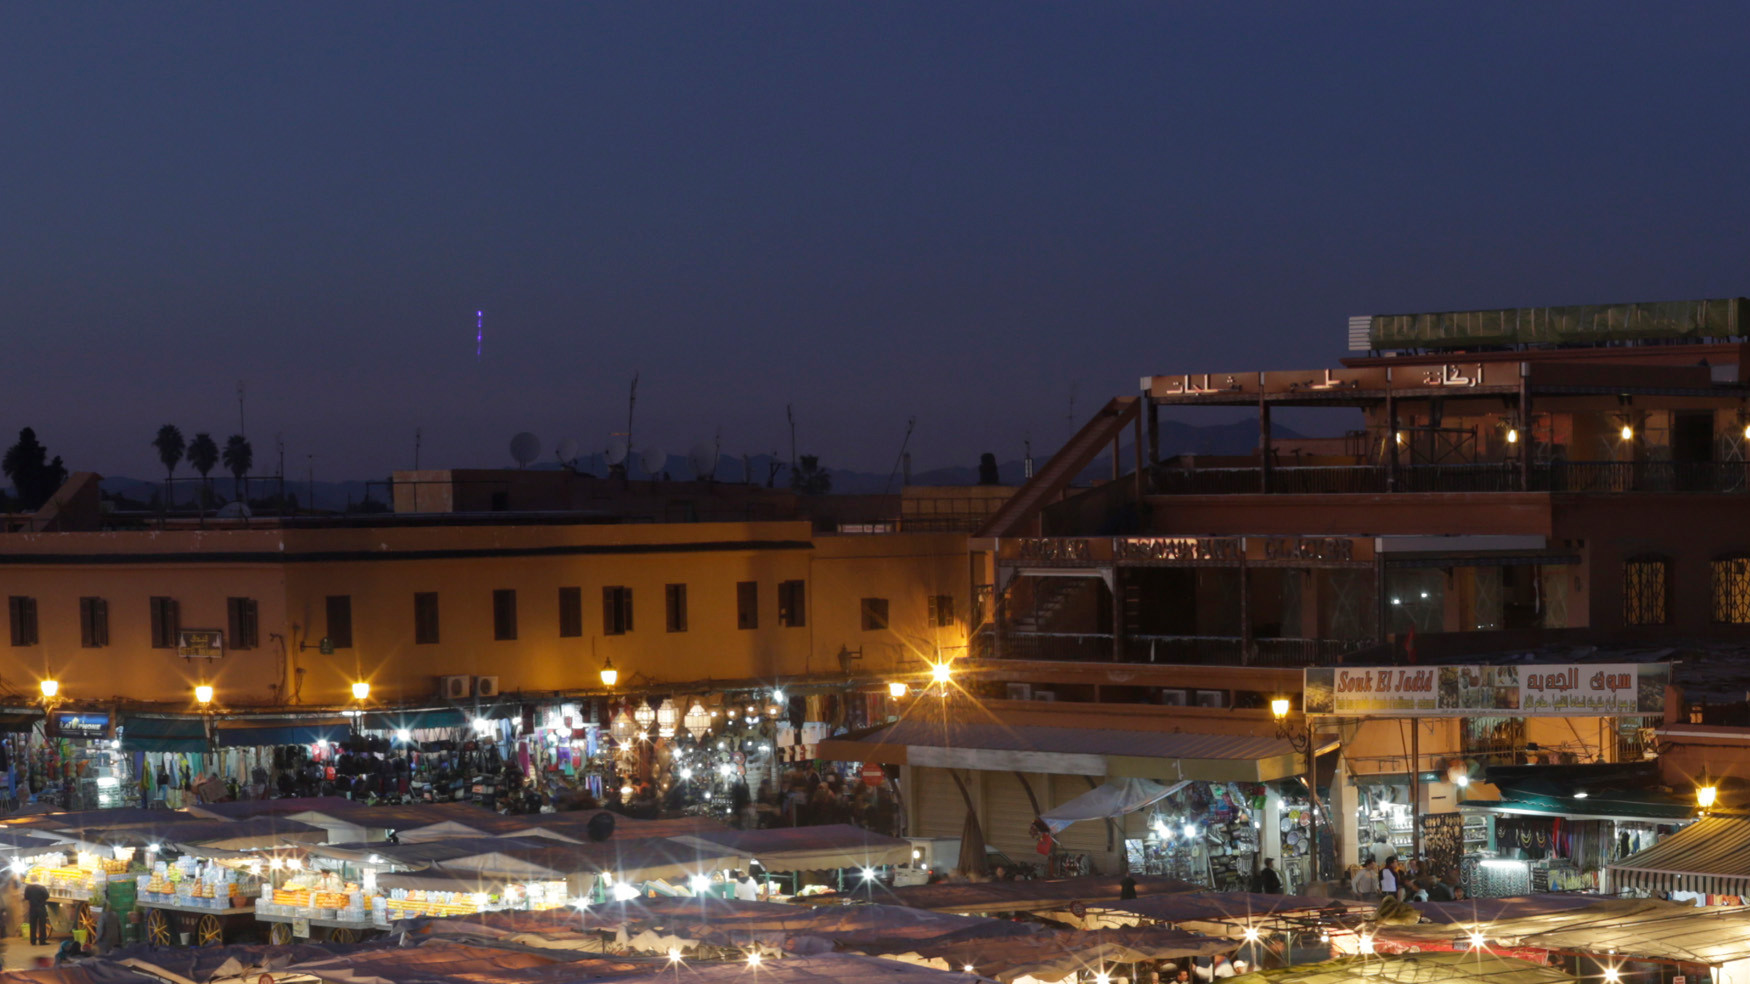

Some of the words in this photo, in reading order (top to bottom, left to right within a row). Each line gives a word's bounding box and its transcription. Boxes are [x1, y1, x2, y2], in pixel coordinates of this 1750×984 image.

[1338, 671, 1373, 693] Souk
[1375, 671, 1393, 692] El
[1395, 670, 1434, 692] Jadid
[1527, 667, 1579, 692] الجديد
[1590, 671, 1632, 693] سوق
